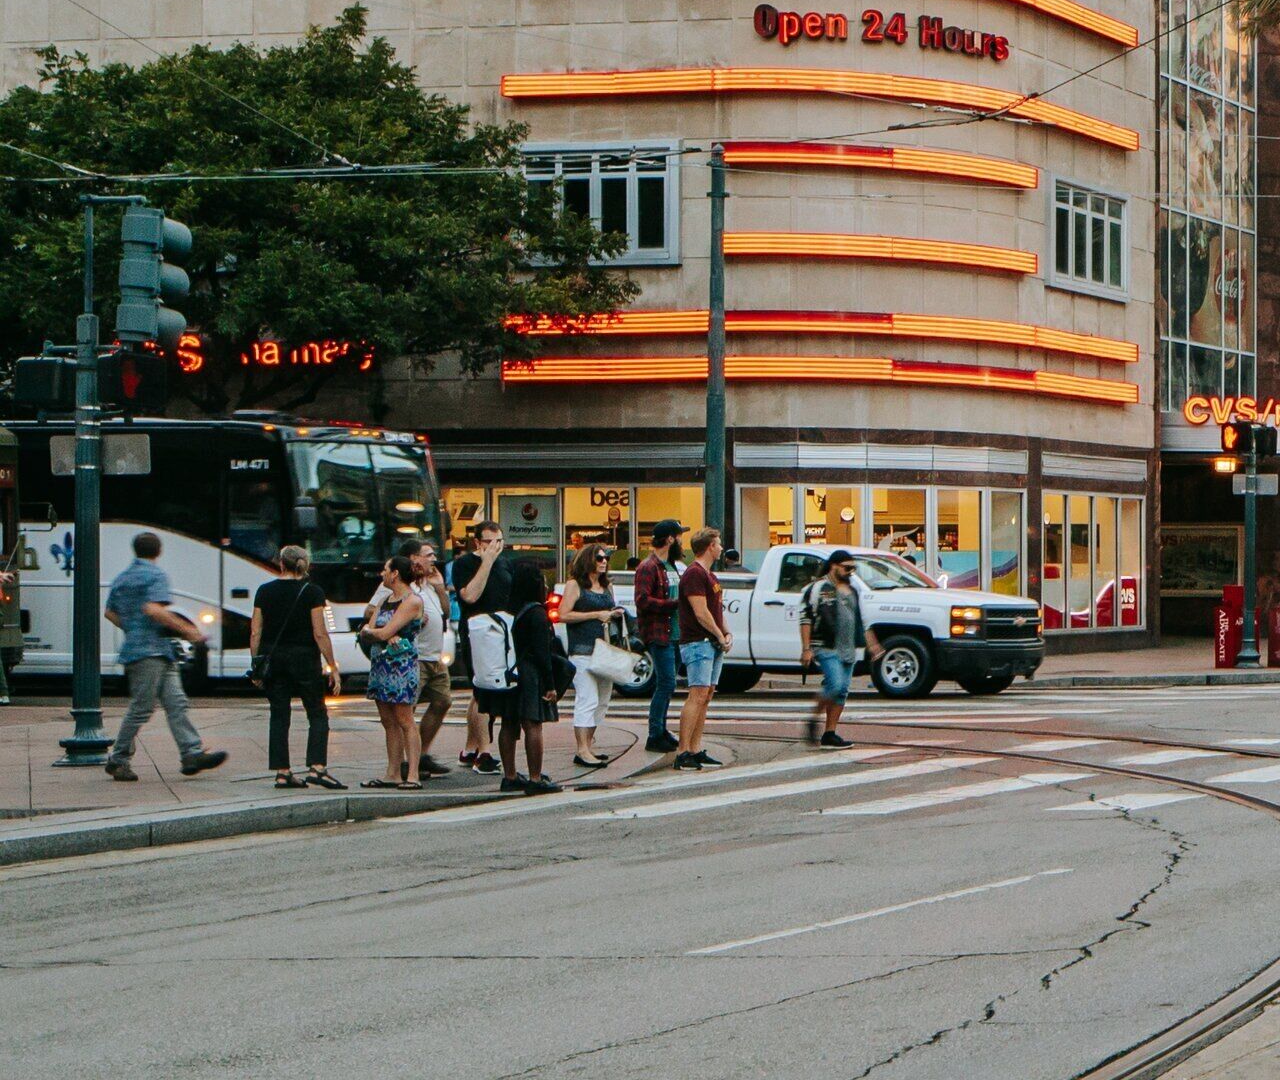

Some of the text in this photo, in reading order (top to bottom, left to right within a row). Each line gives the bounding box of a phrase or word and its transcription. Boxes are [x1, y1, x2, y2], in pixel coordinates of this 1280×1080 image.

[753, 3, 1010, 62] Open 24 Hours
[508, 525, 553, 535] MoneyGram
